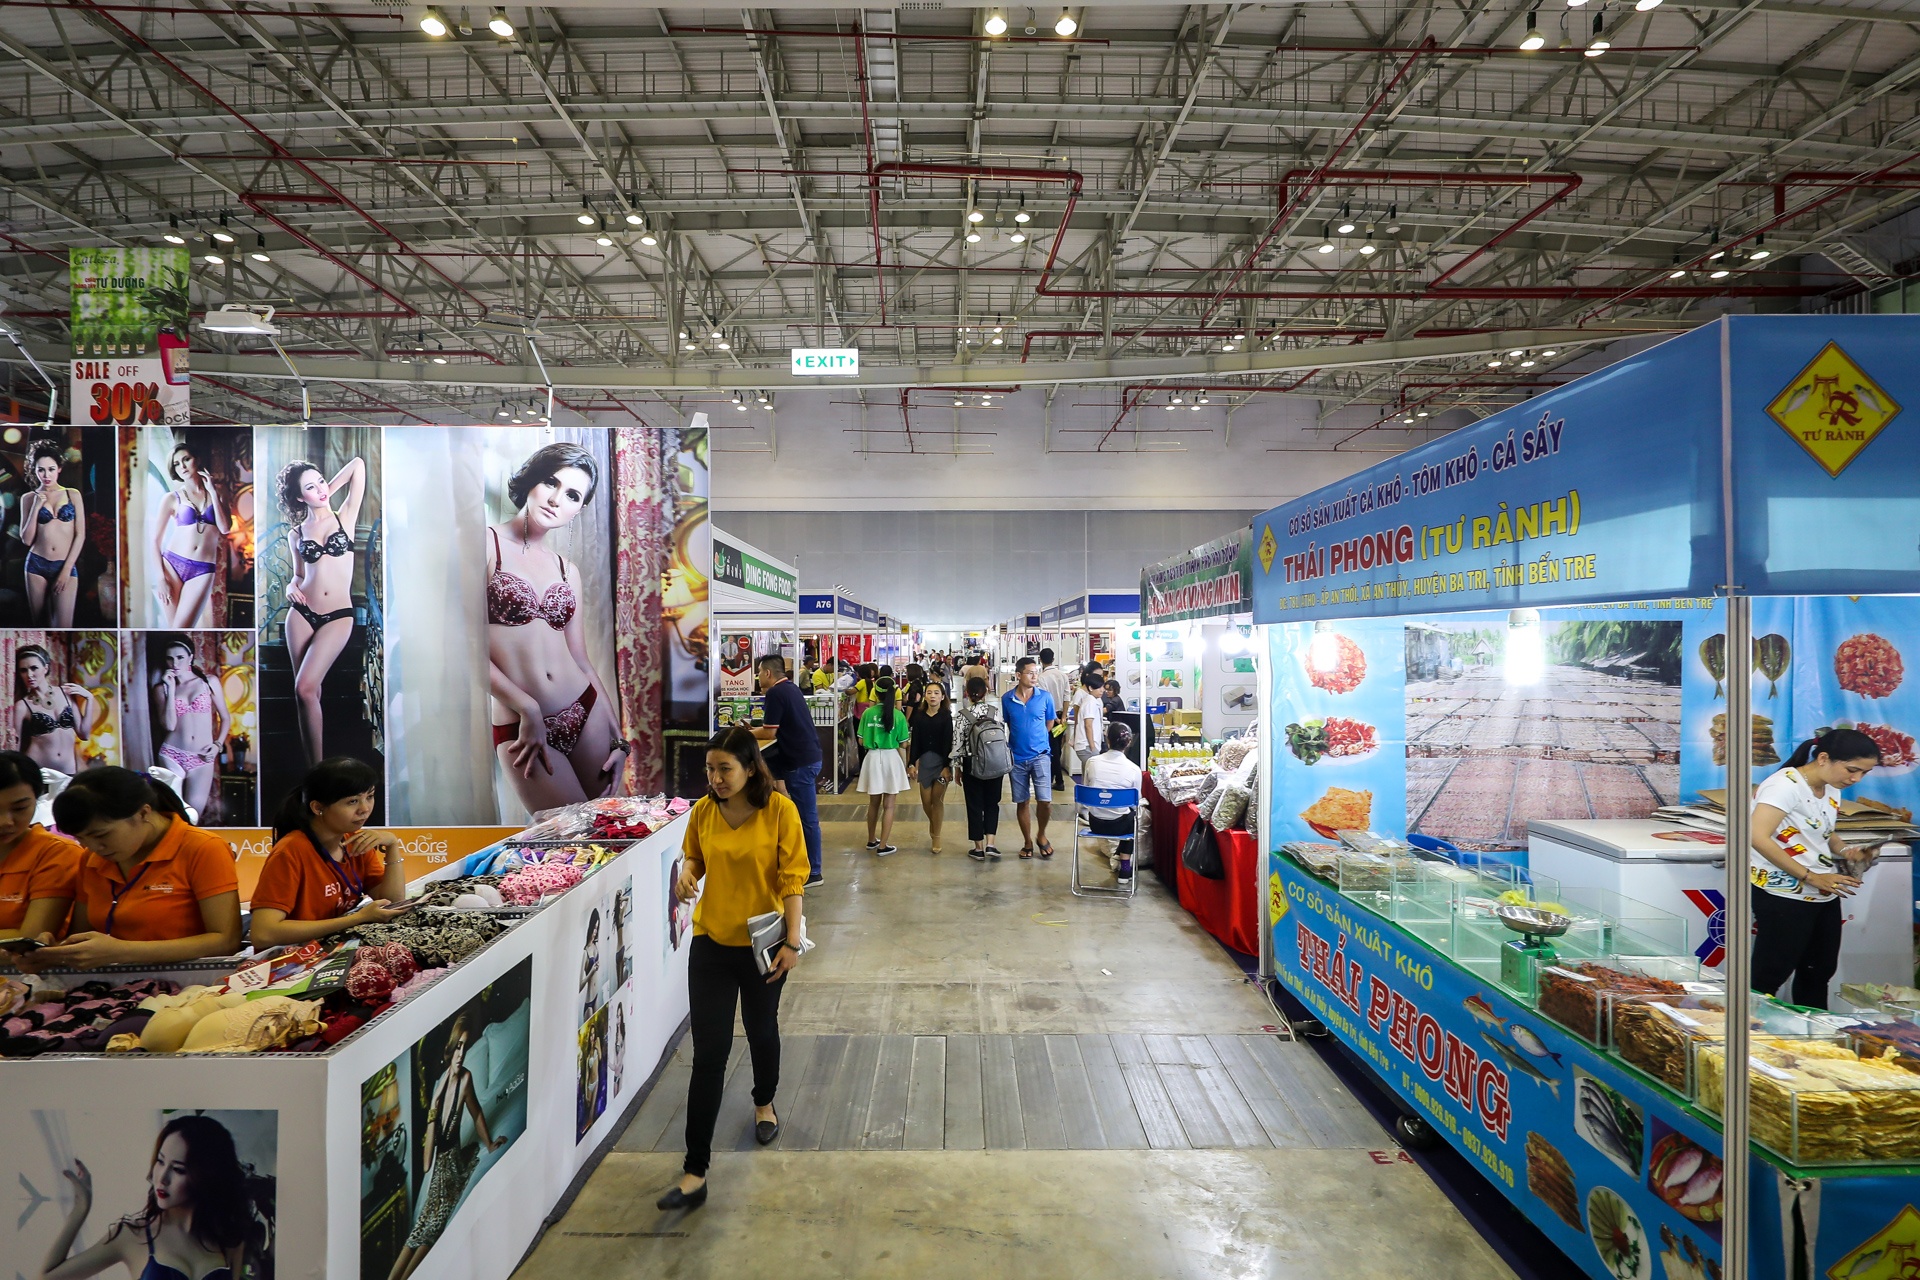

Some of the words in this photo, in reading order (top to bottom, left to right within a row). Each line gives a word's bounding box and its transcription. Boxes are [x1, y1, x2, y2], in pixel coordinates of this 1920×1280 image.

[75, 362, 110, 380] SALE
[118, 366, 139, 377] OFF
[805, 355, 846, 368] EXIT
[89, 382, 165, 425] 30%
[164, 411, 189, 425] OCK
[1802, 429, 1822, 441] TƯ
[1825, 428, 1865, 441] RÀNH
[1313, 500, 1331, 529] SẢN
[1332, 488, 1357, 523] XUẤT
[1359, 484, 1374, 514] CÁ
[1377, 475, 1401, 510] KHÔ
[1413, 462, 1441, 498] TÔM
[1445, 446, 1478, 488] KHÔ
[1492, 429, 1517, 473] CÁ
[1522, 411, 1564, 463] SẤY
[1284, 541, 1324, 584] THÁI
[1330, 525, 1414, 575] PHONG
[1420, 514, 1466, 560] (TƯ
[1472, 489, 1581, 549] RÀNH)
[745, 563, 761, 587] DING
[762, 570, 777, 593] FONG
[778, 577, 791, 597] FOOD
[1331, 589, 1340, 605] AN
[1361, 581, 1370, 601] XÃ
[1373, 583, 1384, 600] AN
[1386, 574, 1411, 600] THỦY,
[1414, 571, 1446, 598] HUYỆN
[1450, 572, 1465, 592] BA
[1467, 568, 1490, 592] TRI,
[1493, 559, 1524, 588] TỈNH
[1528, 551, 1559, 584] BẾN
[1563, 554, 1597, 580] TRE
[816, 600, 831, 608] A76
[1288, 881, 1305, 902] CƠ
[1307, 891, 1324, 915] SỞ
[1325, 903, 1351, 934] SẢN
[1395, 950, 1433, 991] KHÔ
[1297, 920, 1363, 1017] THÁI
[1367, 974, 1512, 1144] PHONG
